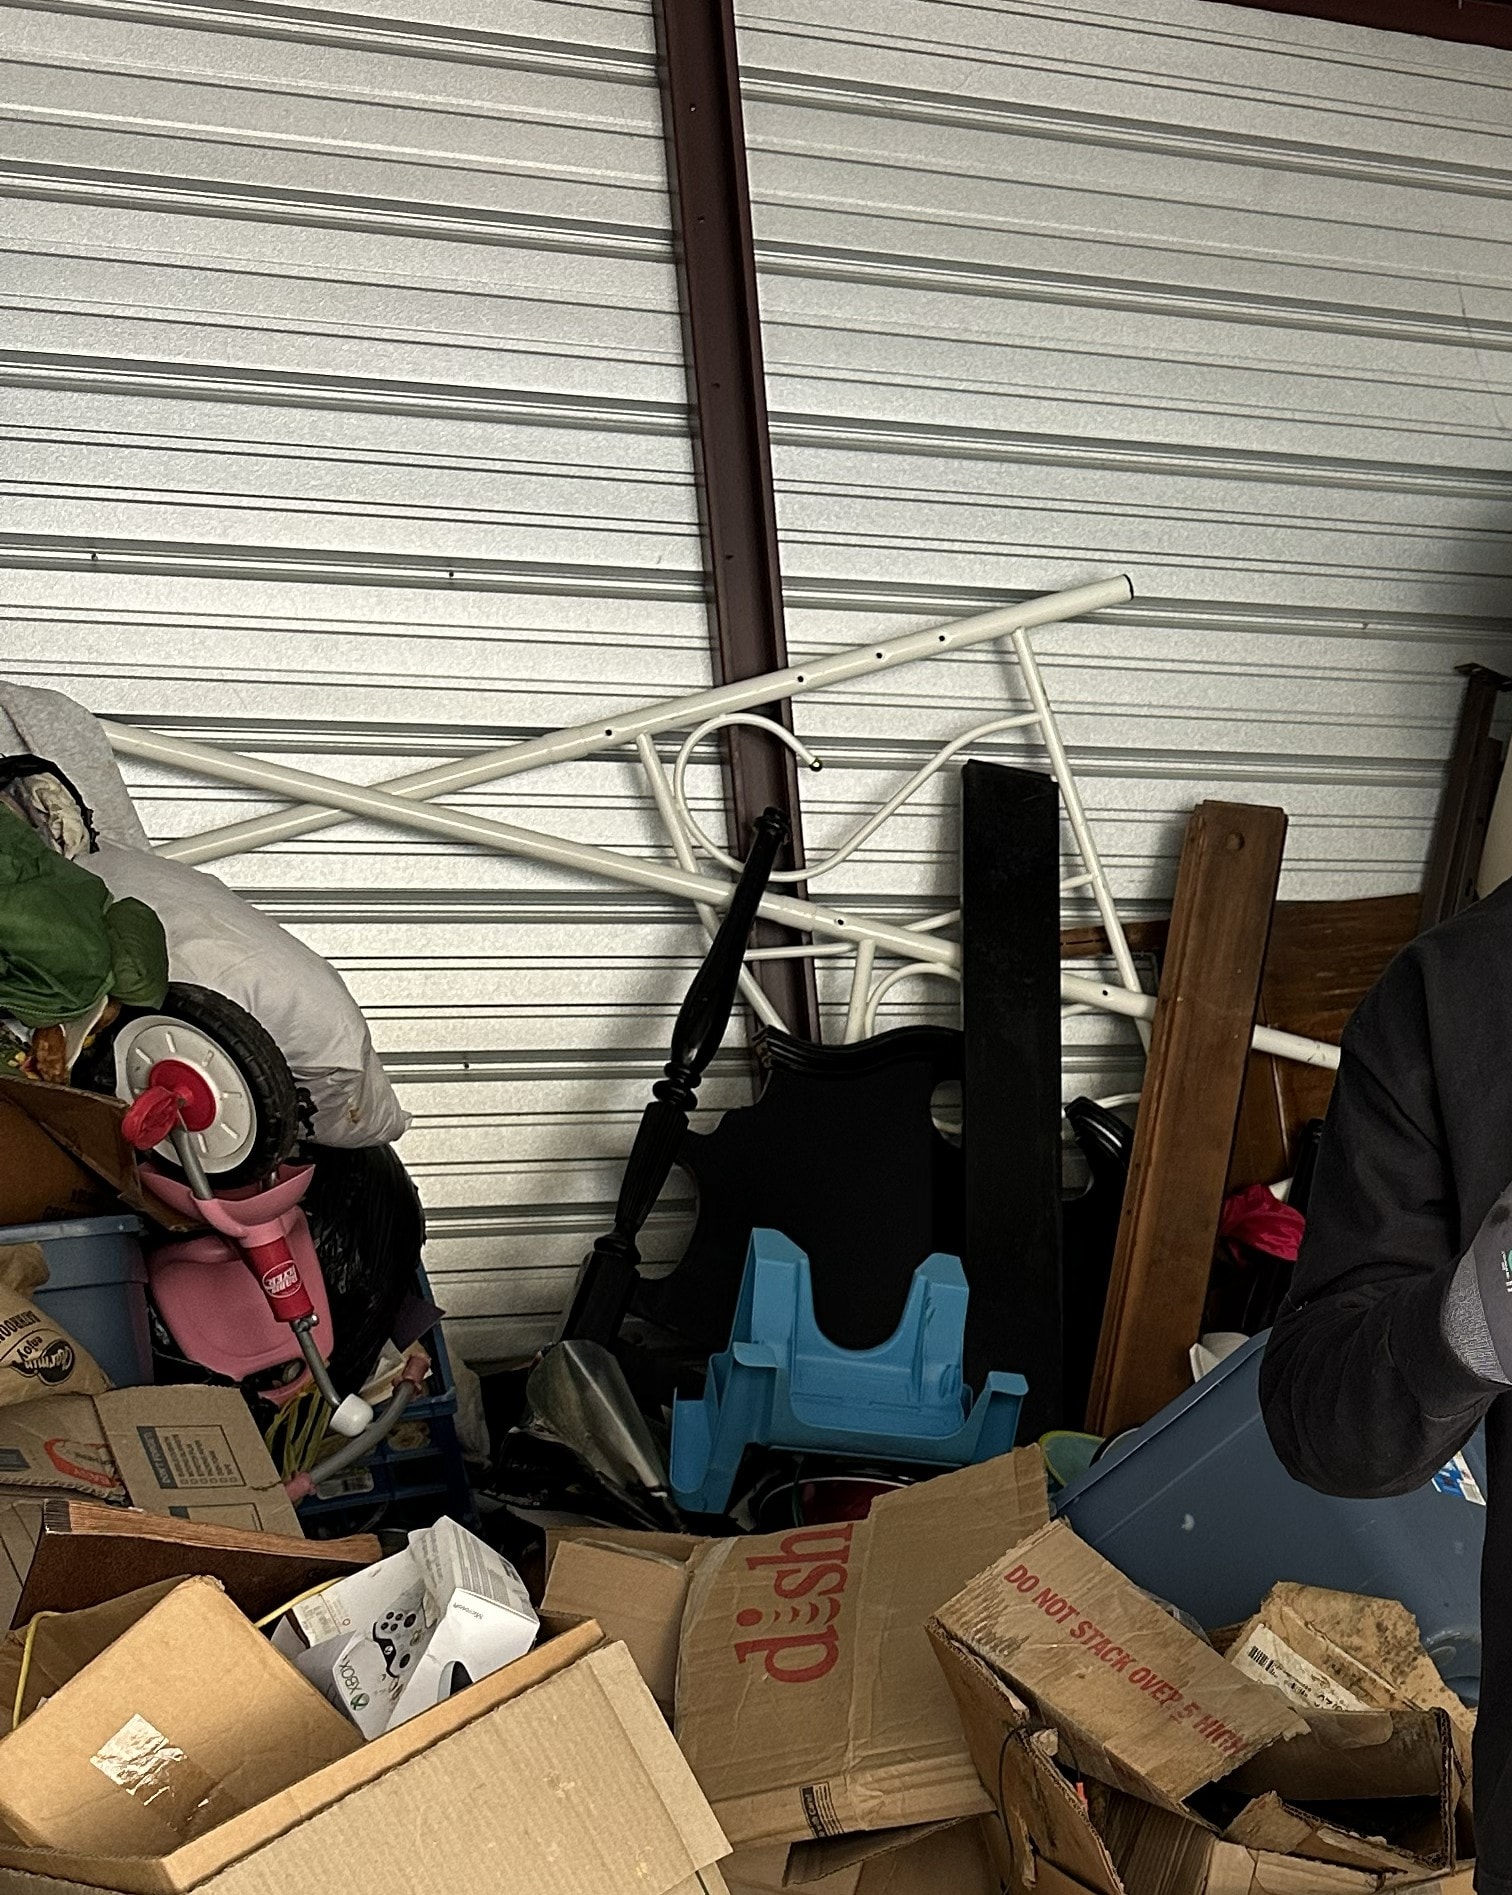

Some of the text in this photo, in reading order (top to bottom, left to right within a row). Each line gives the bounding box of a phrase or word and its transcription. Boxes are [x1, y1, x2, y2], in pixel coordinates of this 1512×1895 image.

[734, 1522, 855, 1683] dish
[1003, 1564, 1040, 1593] DO
[1032, 1587, 1080, 1624] NOT
[1070, 1620, 1137, 1672] STACK
[1128, 1666, 1184, 1706] OVER
[338, 1663, 363, 1695] XBOX
